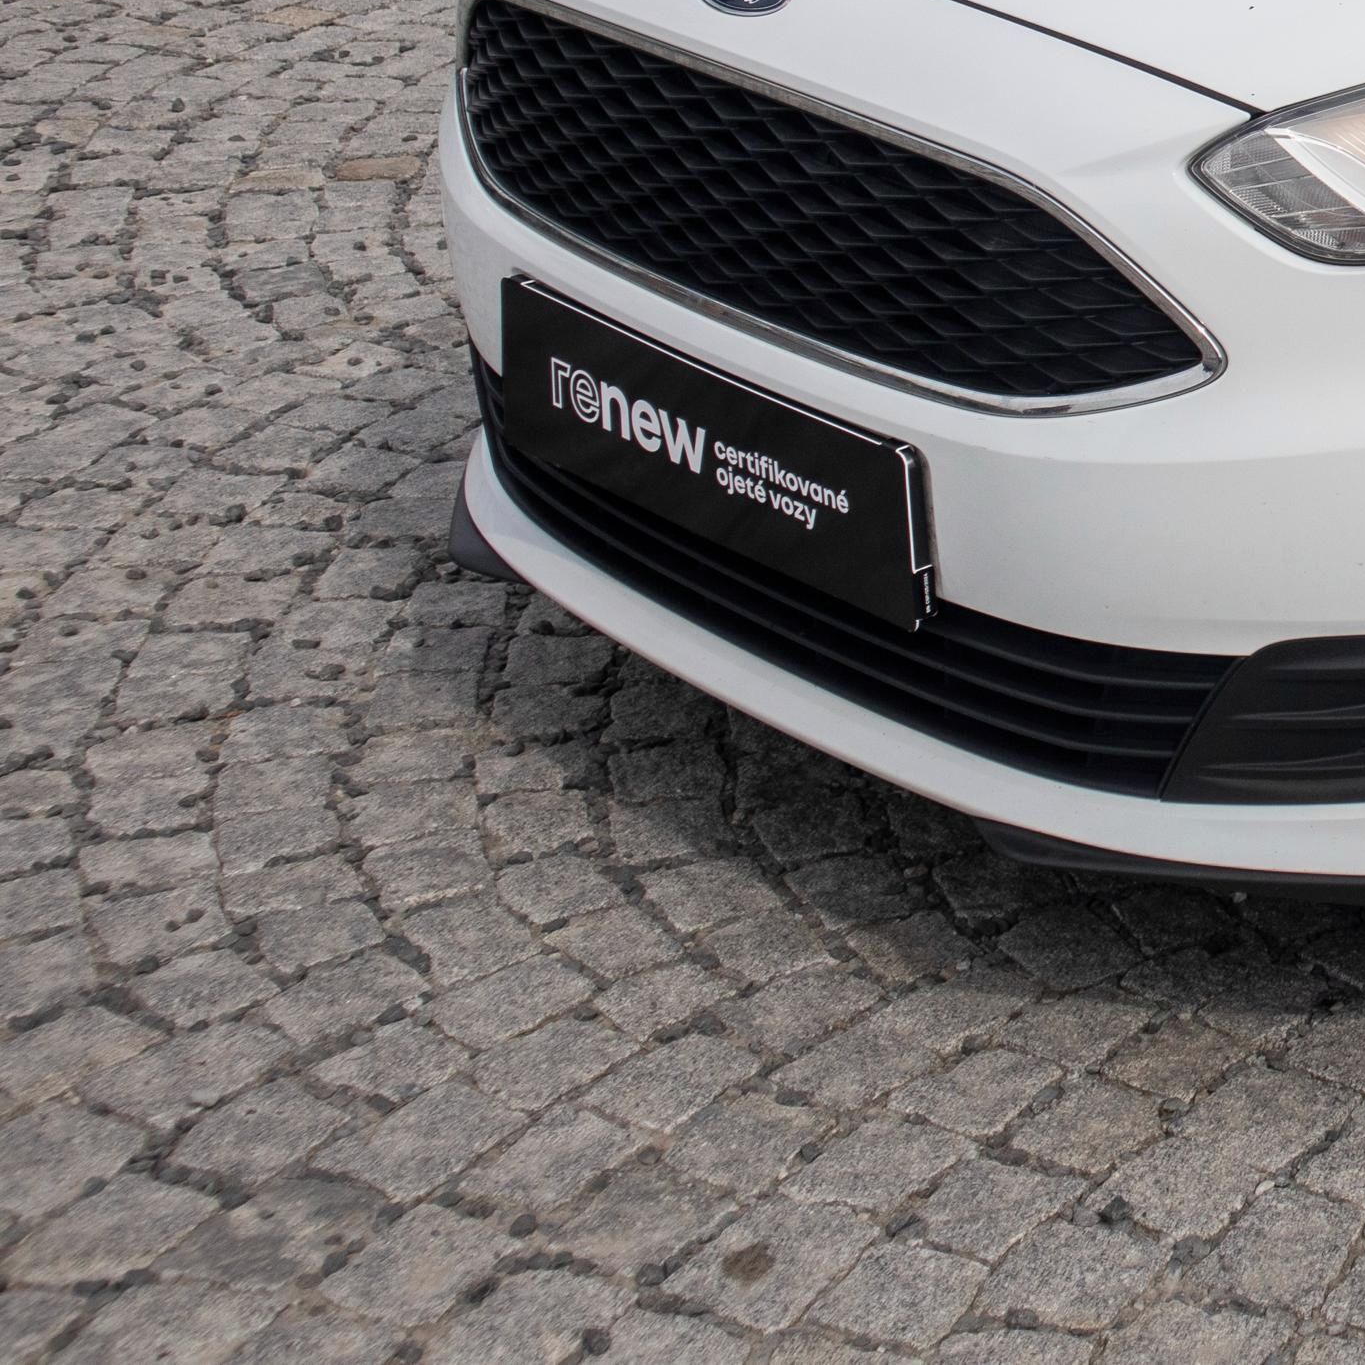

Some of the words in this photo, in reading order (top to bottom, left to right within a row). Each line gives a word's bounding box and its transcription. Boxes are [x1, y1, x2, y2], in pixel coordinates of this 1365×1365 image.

[551, 356, 706, 474] renew
[714, 441, 849, 514] certifikované
[716, 466, 766, 503] ojeté
[768, 489, 817, 530] vozy
